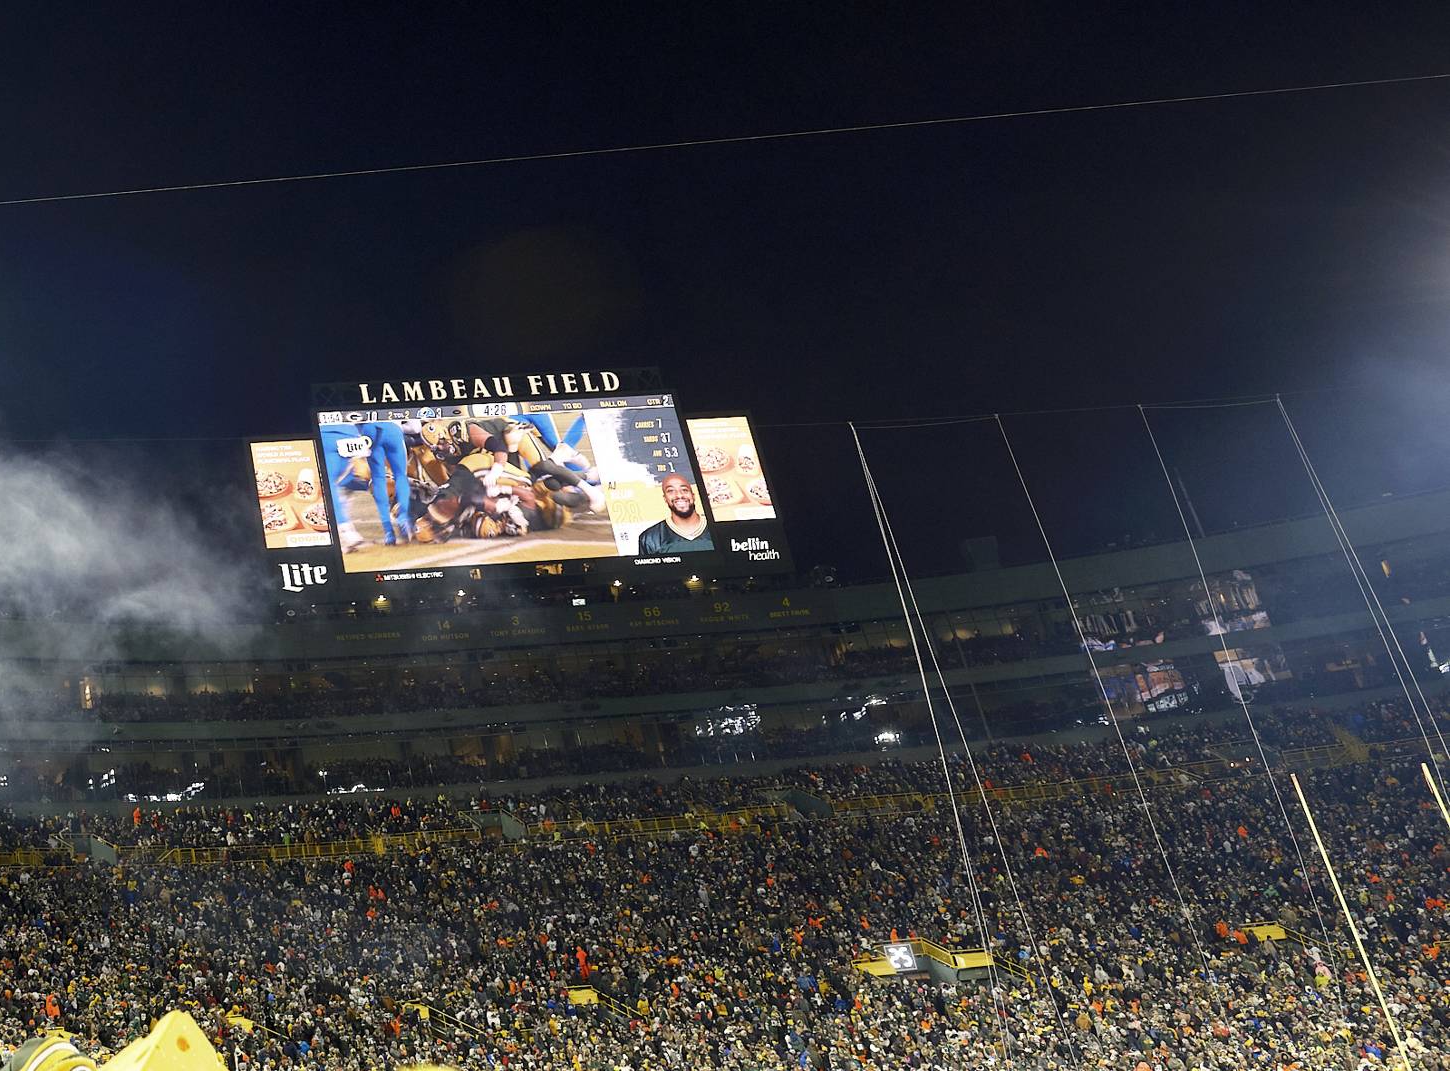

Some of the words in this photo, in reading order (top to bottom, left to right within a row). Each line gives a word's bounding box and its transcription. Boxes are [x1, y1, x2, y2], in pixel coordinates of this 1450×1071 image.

[358, 376, 514, 404] LAMBEAU
[527, 371, 621, 396] FIELD
[530, 404, 551, 412] DOWN
[366, 411, 378, 421] 10
[660, 432, 671, 443] 37
[346, 443, 364, 453] Lite
[664, 446, 679, 458] 5.3
[668, 462, 676, 473] 1
[730, 537, 769, 551] bellin
[748, 548, 780, 561] health
[634, 557, 661, 565] DIAMOND
[662, 556, 681, 564] VISION
[278, 562, 328, 593] Lite
[383, 573, 415, 581] MITSUBISHI
[416, 571, 444, 579] ELECTRIC
[712, 601, 732, 613] 92
[782, 597, 790, 607] 4
[576, 610, 592, 621] 15
[644, 606, 661, 617] 66
[437, 619, 453, 631] 14
[510, 615, 520, 626] 3
[439, 632, 470, 640] HUTSON
